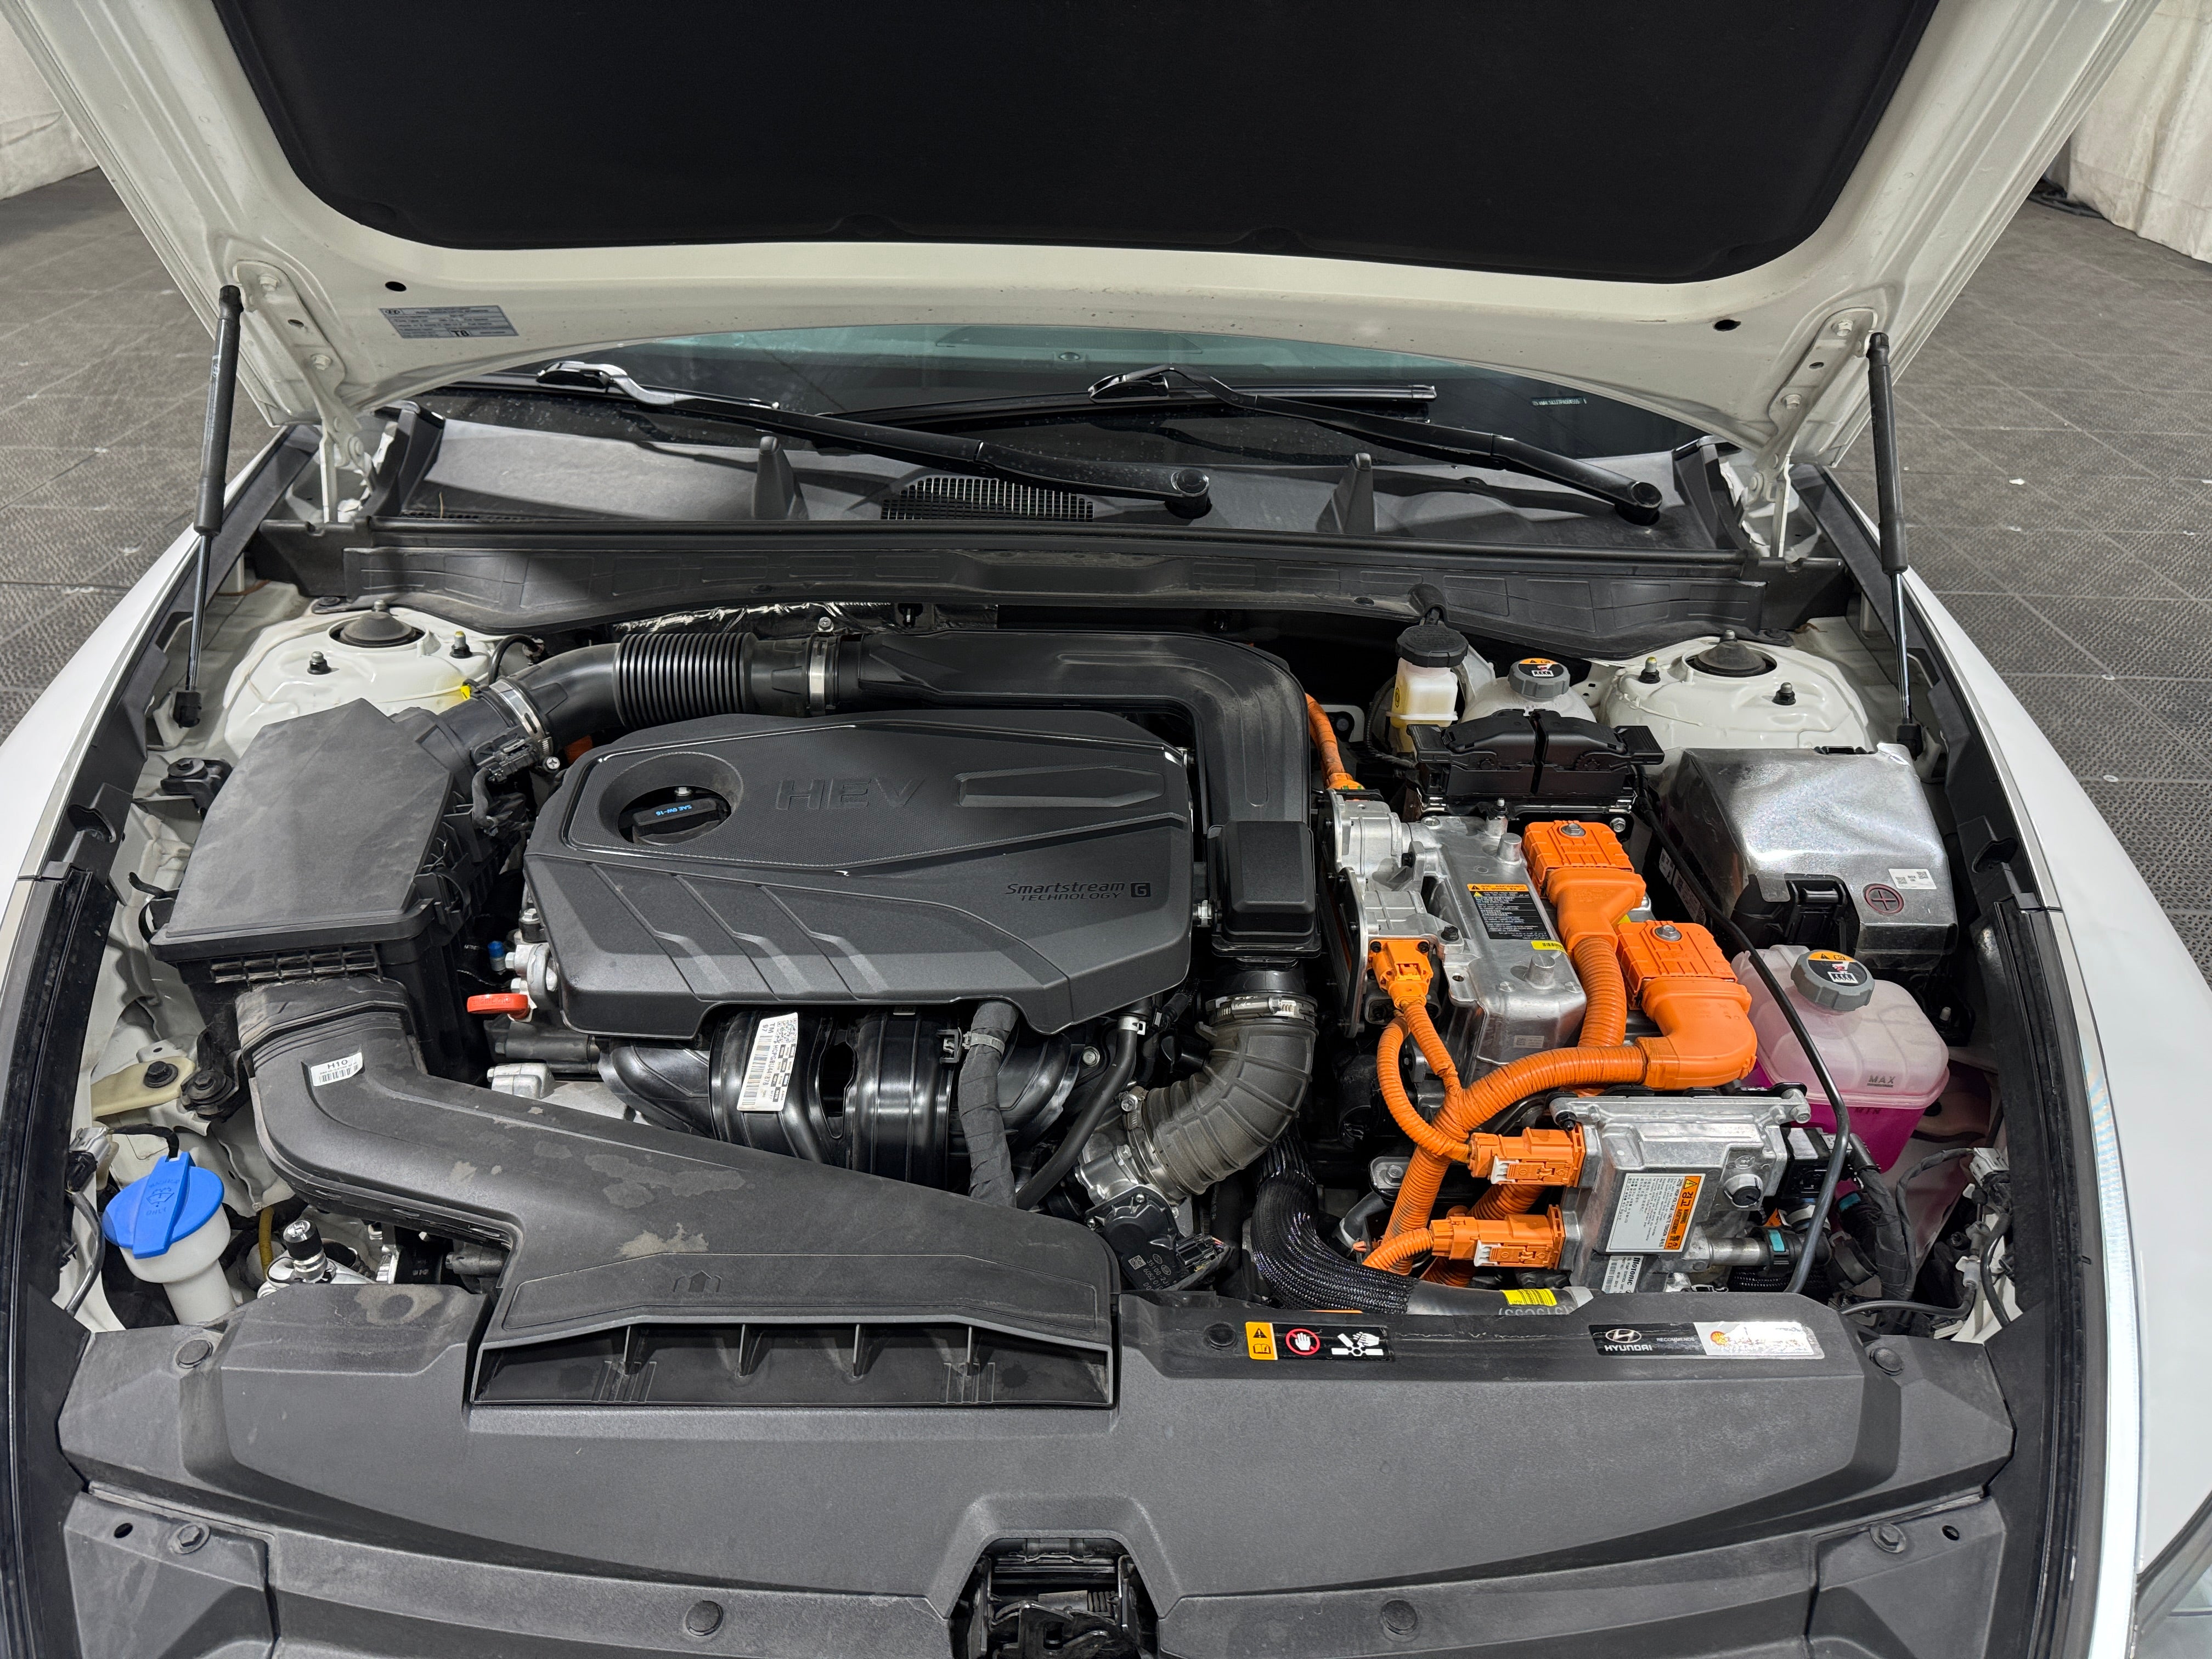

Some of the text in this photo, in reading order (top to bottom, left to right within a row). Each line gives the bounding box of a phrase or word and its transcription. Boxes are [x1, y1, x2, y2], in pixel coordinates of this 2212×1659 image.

[776, 777, 926, 811] HEV
[656, 808, 678, 816] 0W-16
[1005, 882, 1149, 896] Smartstream G
[1021, 892, 1122, 901] TECHNOLOGY
[768, 1022, 775, 1034] TM
[328, 1059, 348, 1069] H10
[1869, 1075, 1895, 1084] MAX
[1679, 1191, 1694, 1206] 경고
